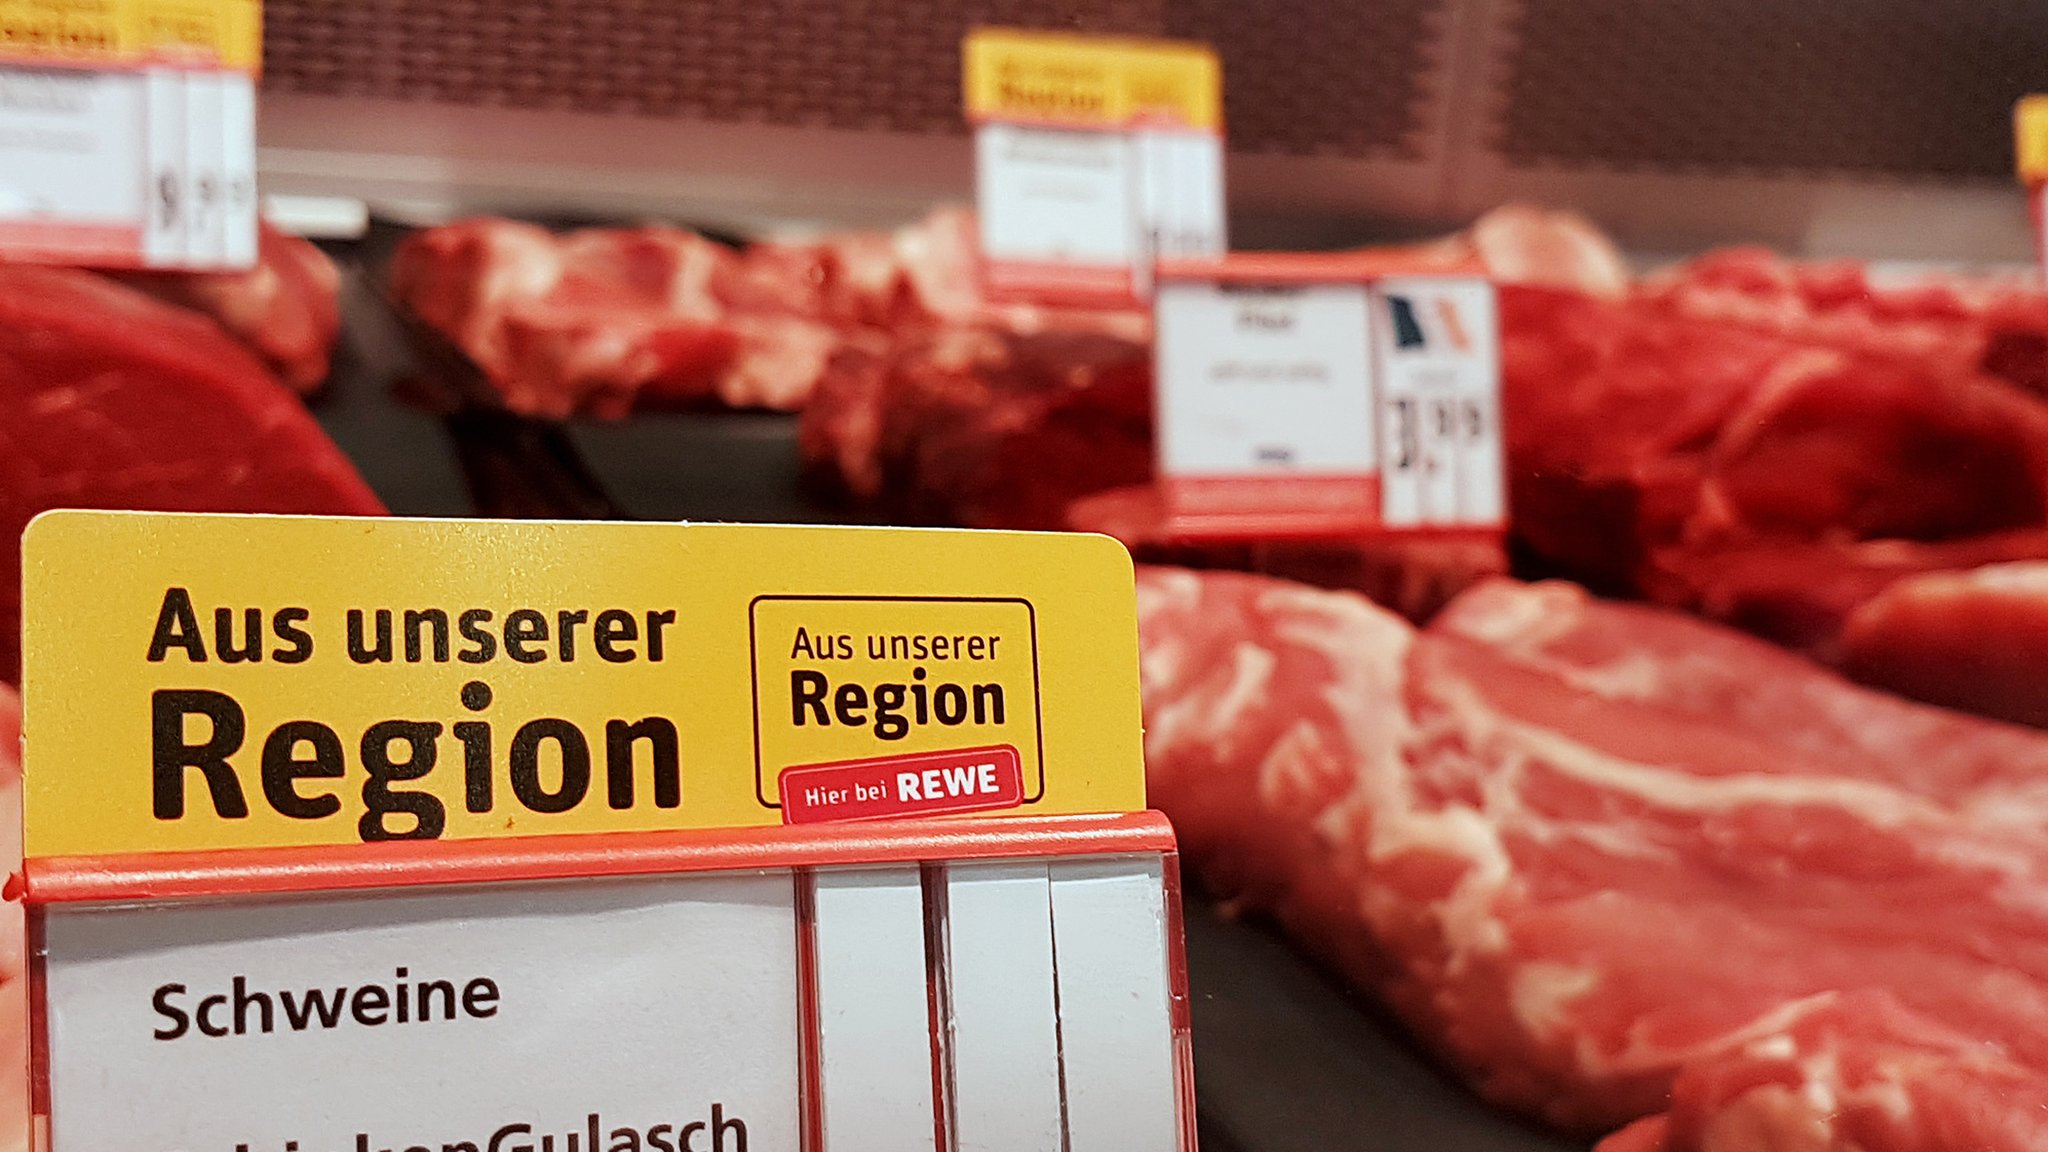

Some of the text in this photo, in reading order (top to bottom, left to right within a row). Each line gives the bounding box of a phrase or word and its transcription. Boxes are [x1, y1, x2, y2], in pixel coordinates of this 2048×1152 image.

[148, 587, 676, 664] Aus unserer
[791, 627, 1000, 660] Aus unserer
[791, 666, 1005, 741] Region
[152, 680, 681, 842] Region
[805, 763, 1001, 807] Hier bei REWE
[152, 967, 500, 1040] Schweine
